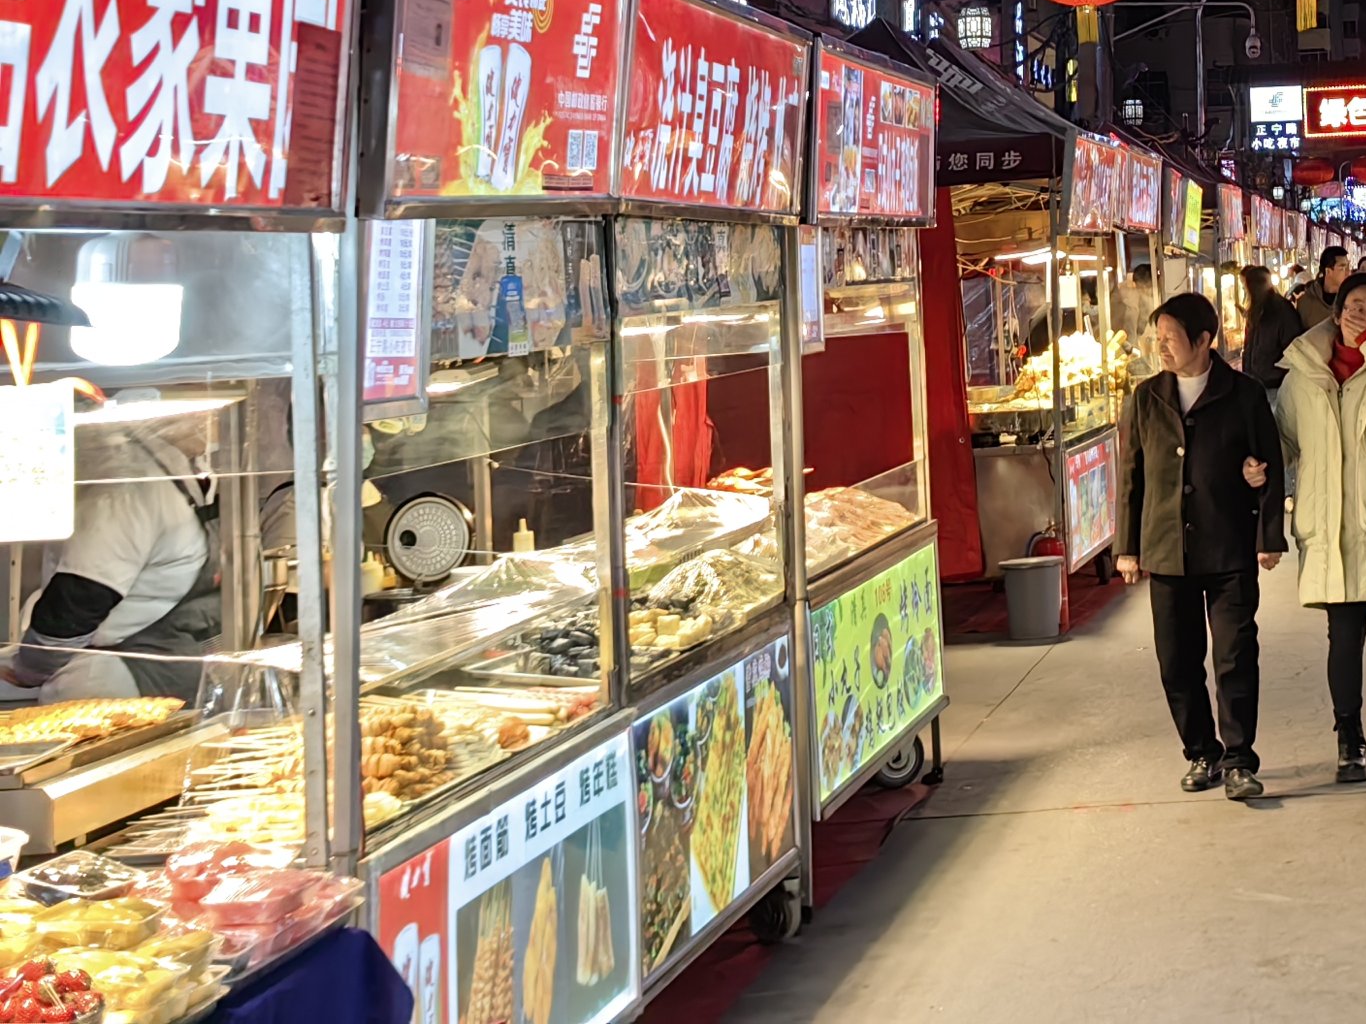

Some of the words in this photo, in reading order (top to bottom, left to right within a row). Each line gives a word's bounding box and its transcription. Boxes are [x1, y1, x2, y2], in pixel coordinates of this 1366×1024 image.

[1251, 136, 1300, 151] 小吃夜市
[464, 814, 509, 882] 烤面筋
[525, 780, 567, 842] 烤土豆
[579, 751, 618, 807] 烤年糕
